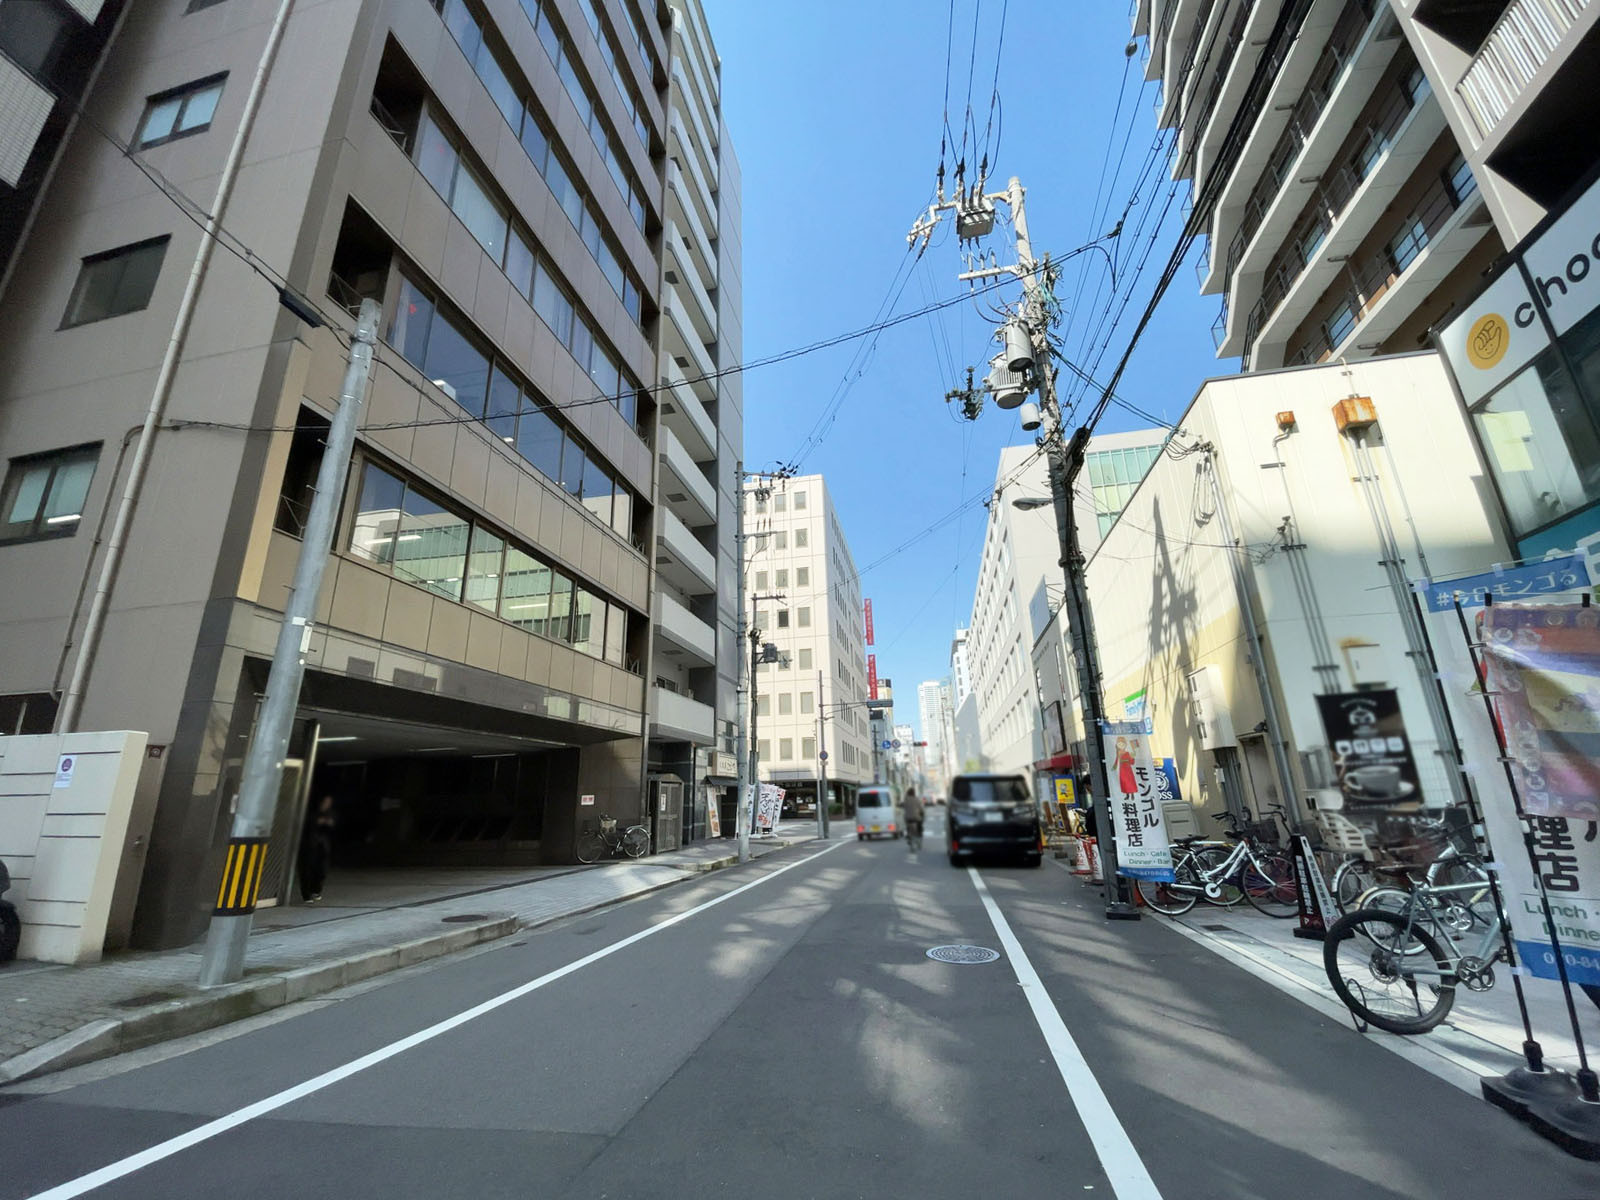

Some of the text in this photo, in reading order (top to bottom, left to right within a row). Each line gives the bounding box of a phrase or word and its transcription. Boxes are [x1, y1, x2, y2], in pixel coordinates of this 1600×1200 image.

[1136, 767, 1159, 828] モンゴル
[1122, 803, 1143, 847] 料理店
